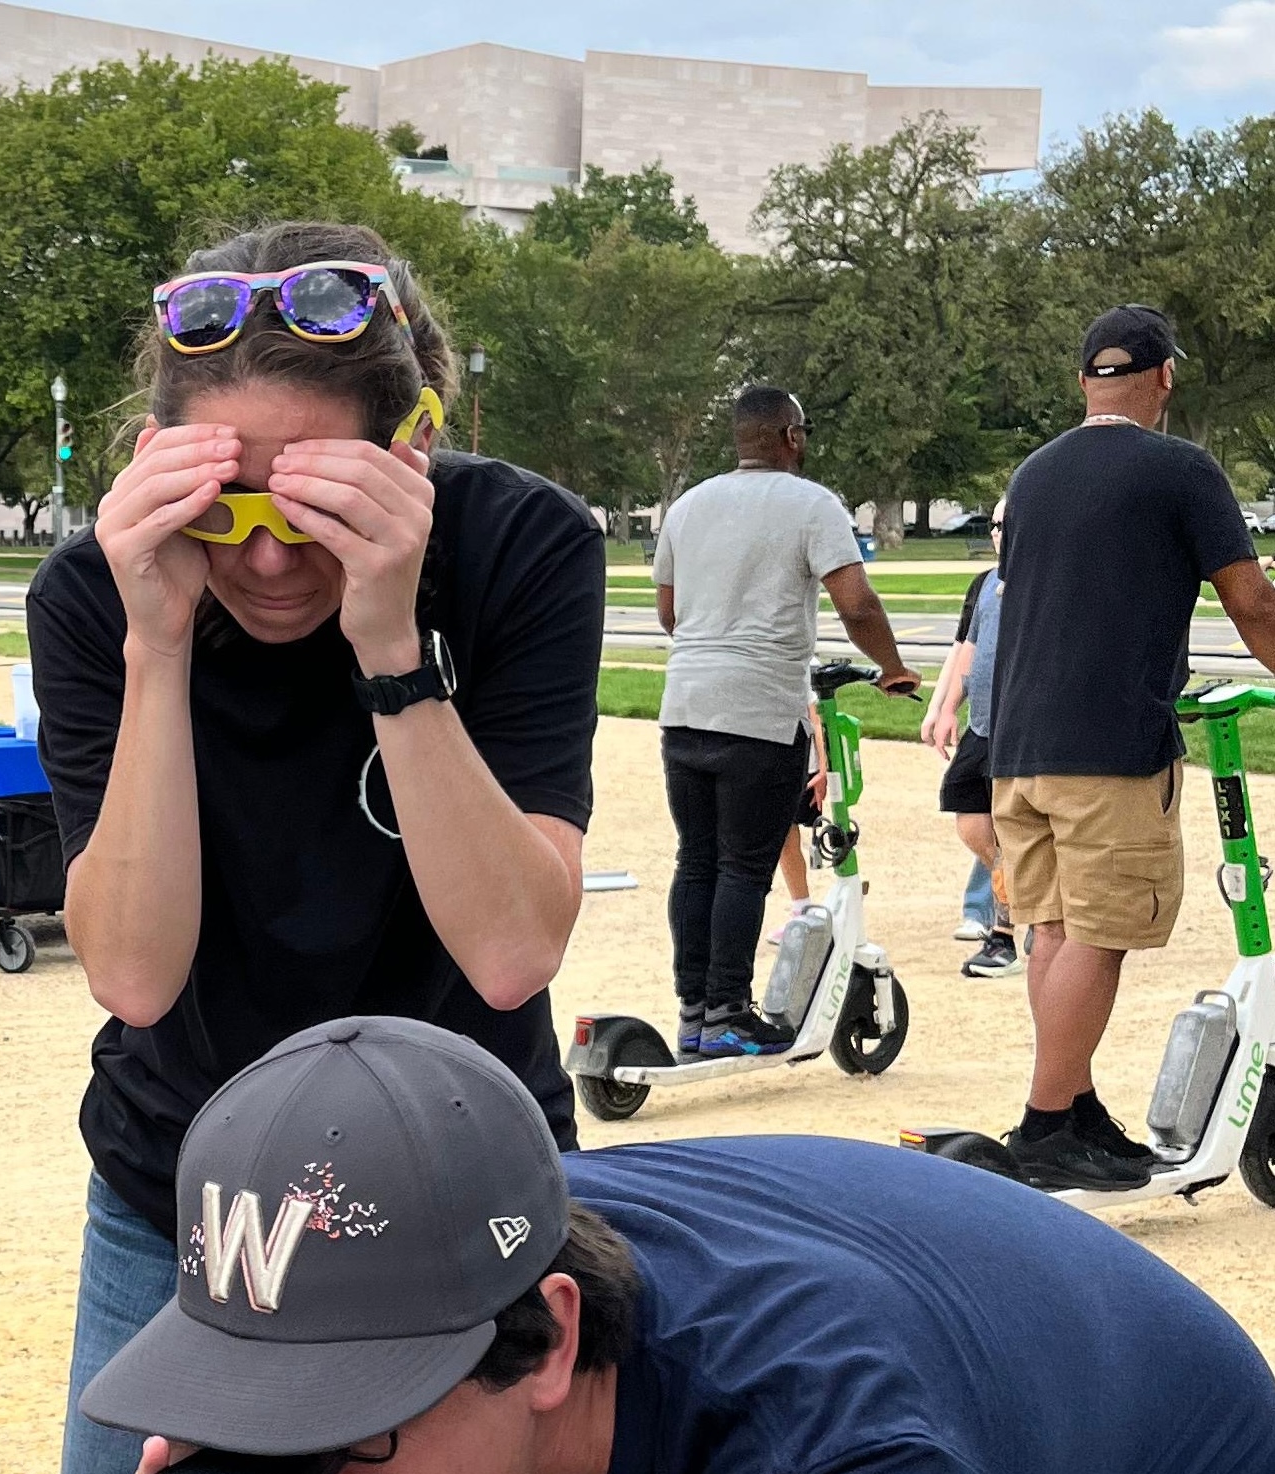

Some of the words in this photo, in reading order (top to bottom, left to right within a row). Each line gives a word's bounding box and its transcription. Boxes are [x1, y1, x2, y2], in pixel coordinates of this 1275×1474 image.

[821, 952, 850, 1021] Lime
[1227, 1041, 1265, 1129] Lime
[201, 1179, 314, 1315] W
